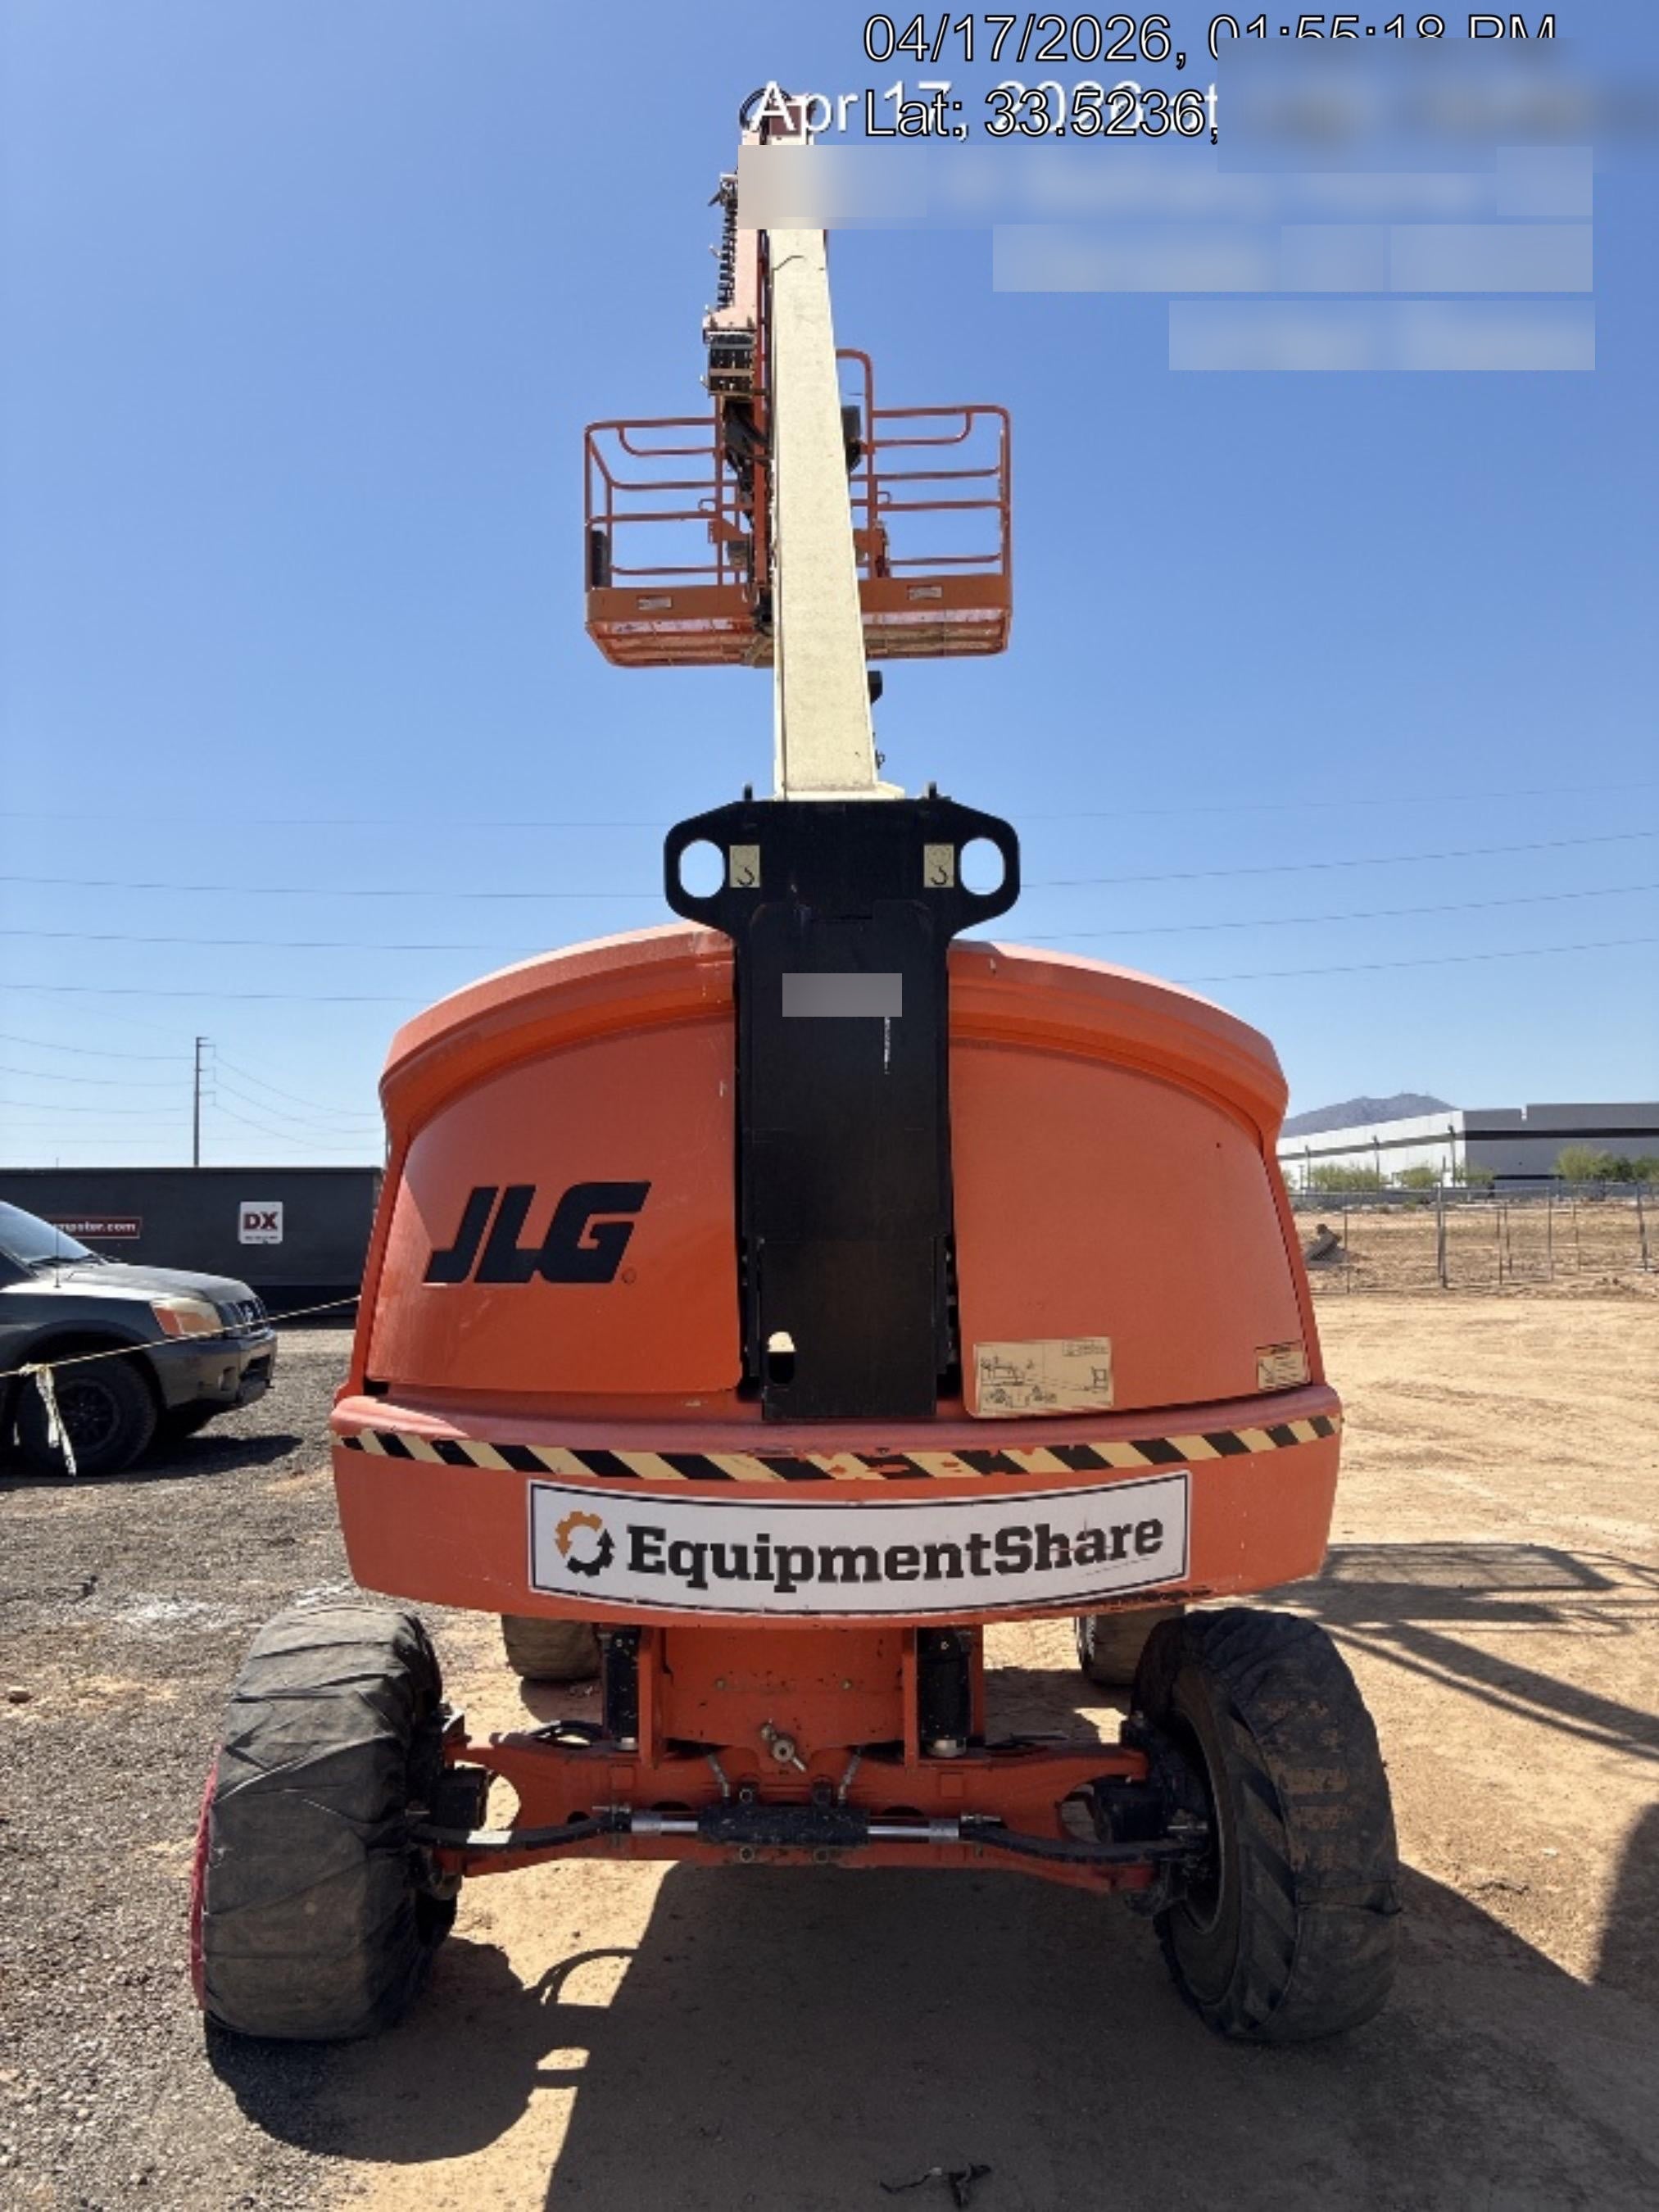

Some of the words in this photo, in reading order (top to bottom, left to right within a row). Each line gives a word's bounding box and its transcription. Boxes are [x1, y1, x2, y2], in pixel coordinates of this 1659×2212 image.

[243, 1212, 279, 1231] DX
[422, 1181, 652, 1284] JLG
[626, 1517, 1164, 1593] EquipmentShare
